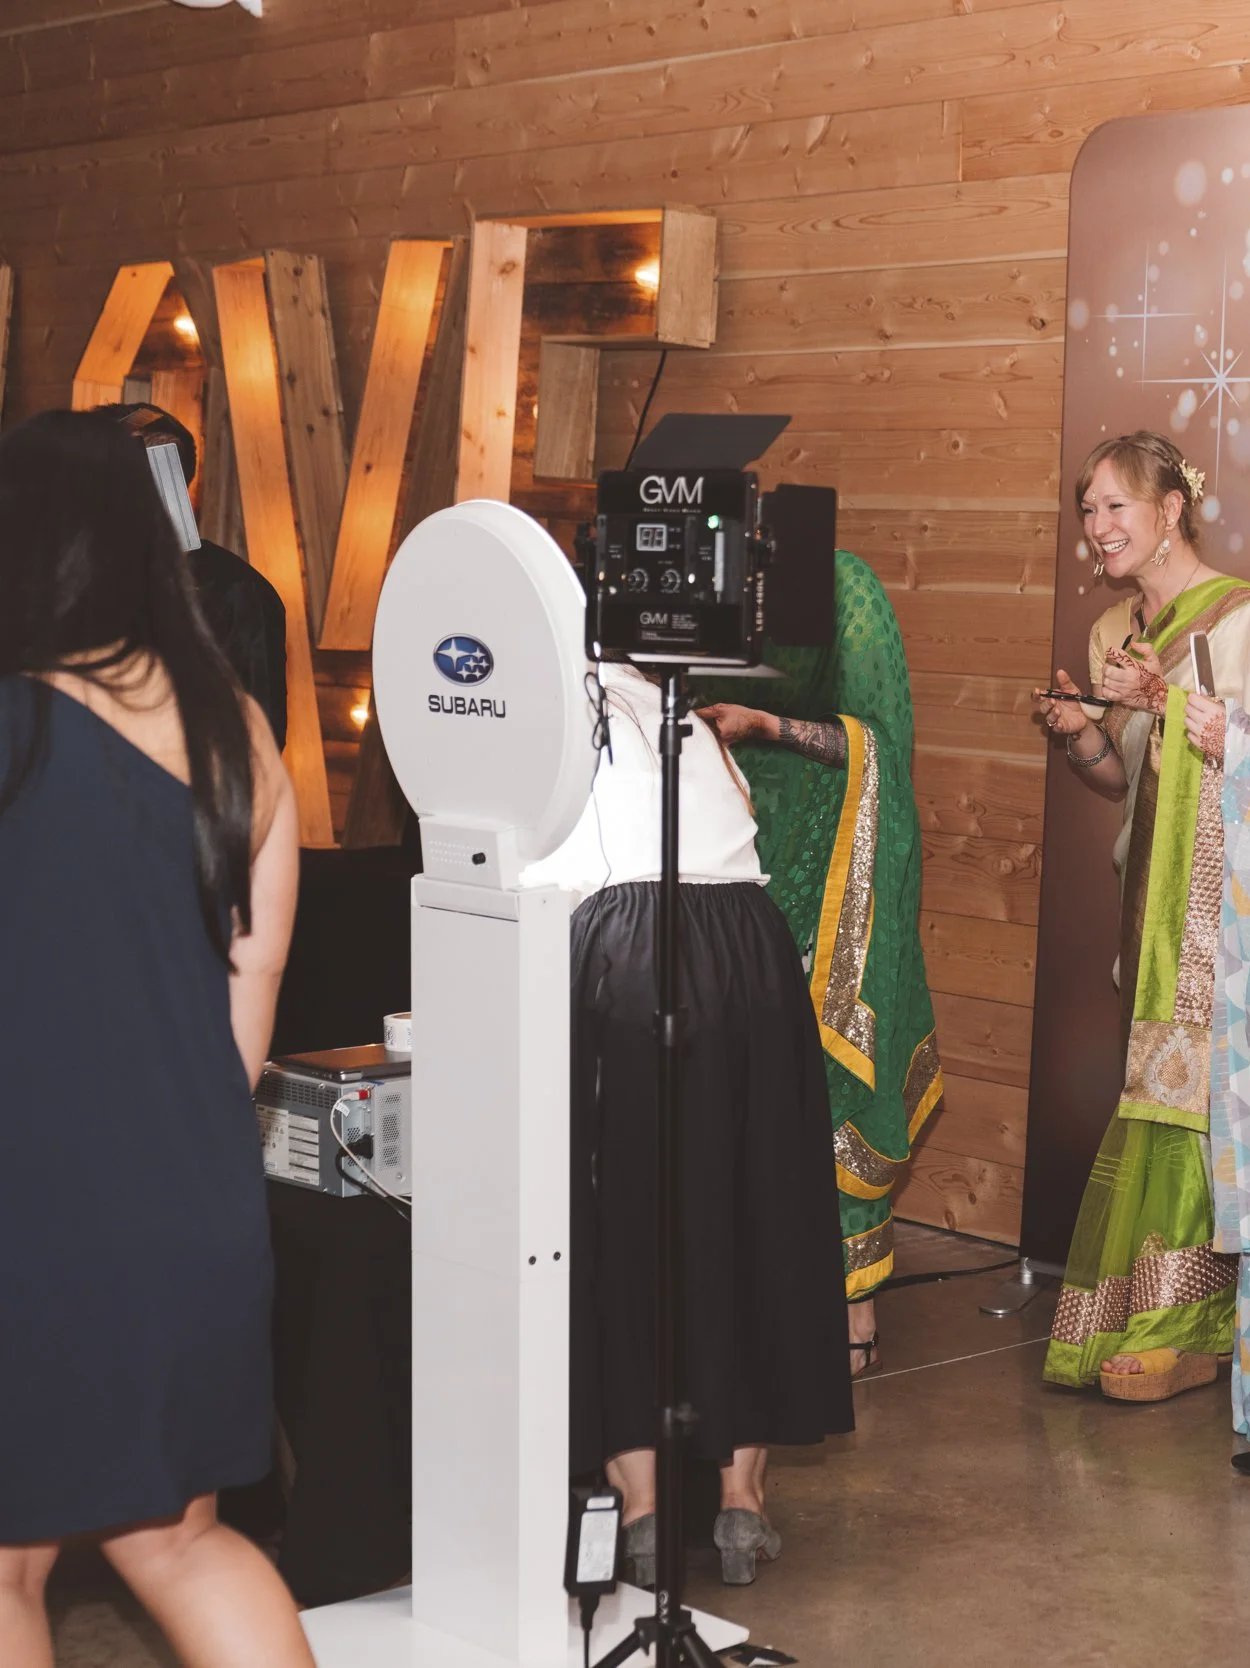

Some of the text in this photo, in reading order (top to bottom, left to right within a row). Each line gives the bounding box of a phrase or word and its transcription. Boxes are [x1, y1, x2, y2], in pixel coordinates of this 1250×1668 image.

[639, 474, 705, 504] GVM
[639, 611, 668, 625] GVM
[428, 694, 507, 719] SUBARU
